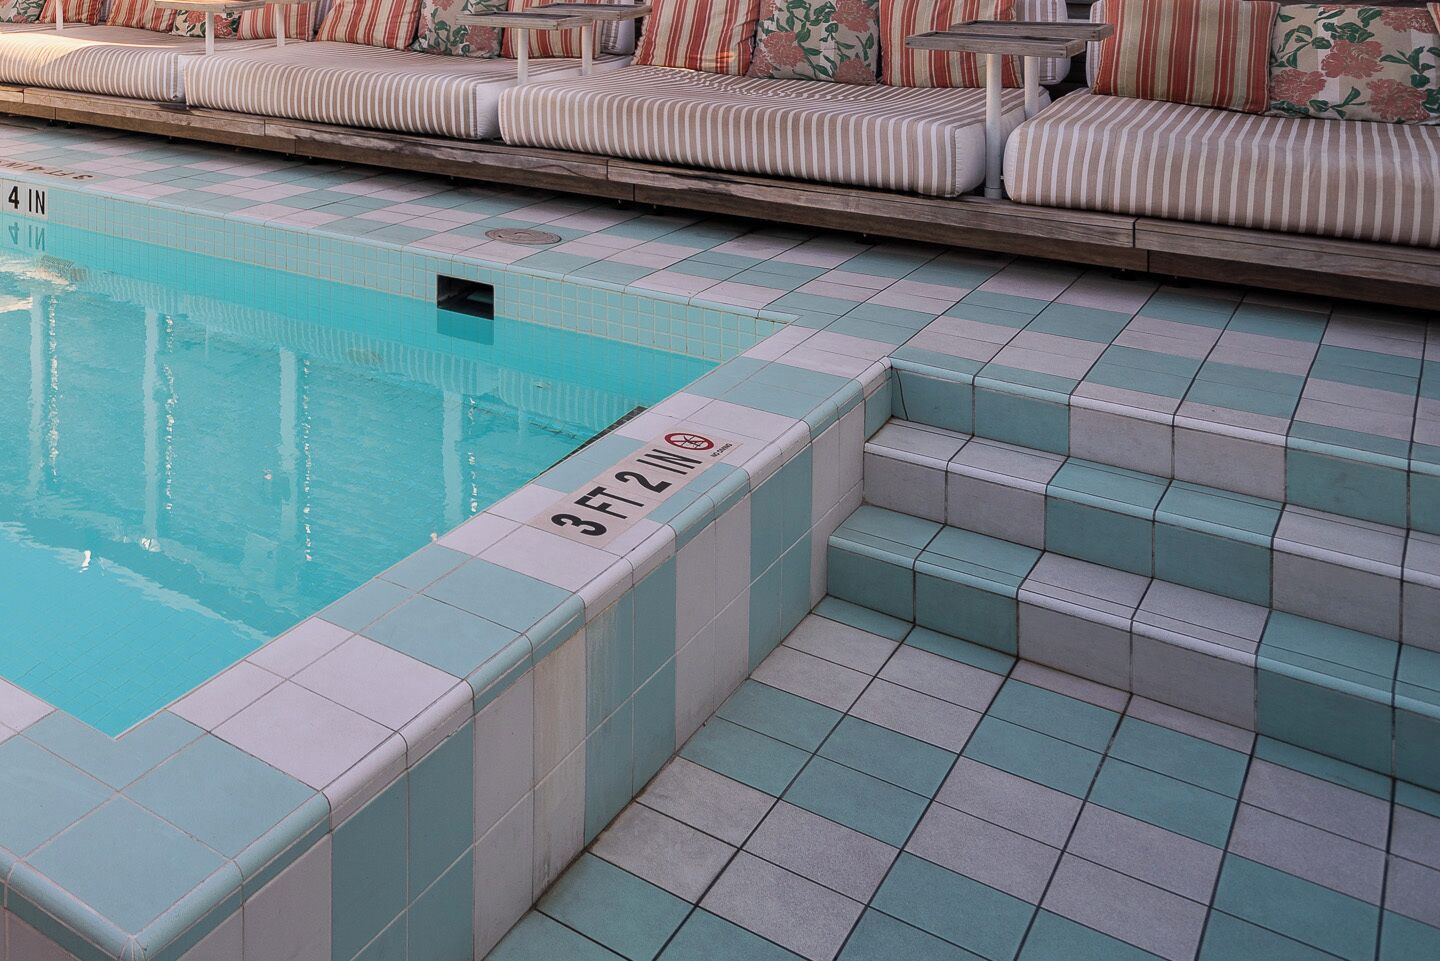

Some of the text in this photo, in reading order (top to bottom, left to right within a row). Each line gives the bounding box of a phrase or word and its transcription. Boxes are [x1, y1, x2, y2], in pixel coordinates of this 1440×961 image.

[8, 186, 20, 209] 4
[28, 188, 45, 215] IN
[551, 448, 703, 536] 3 FT 2 IN
